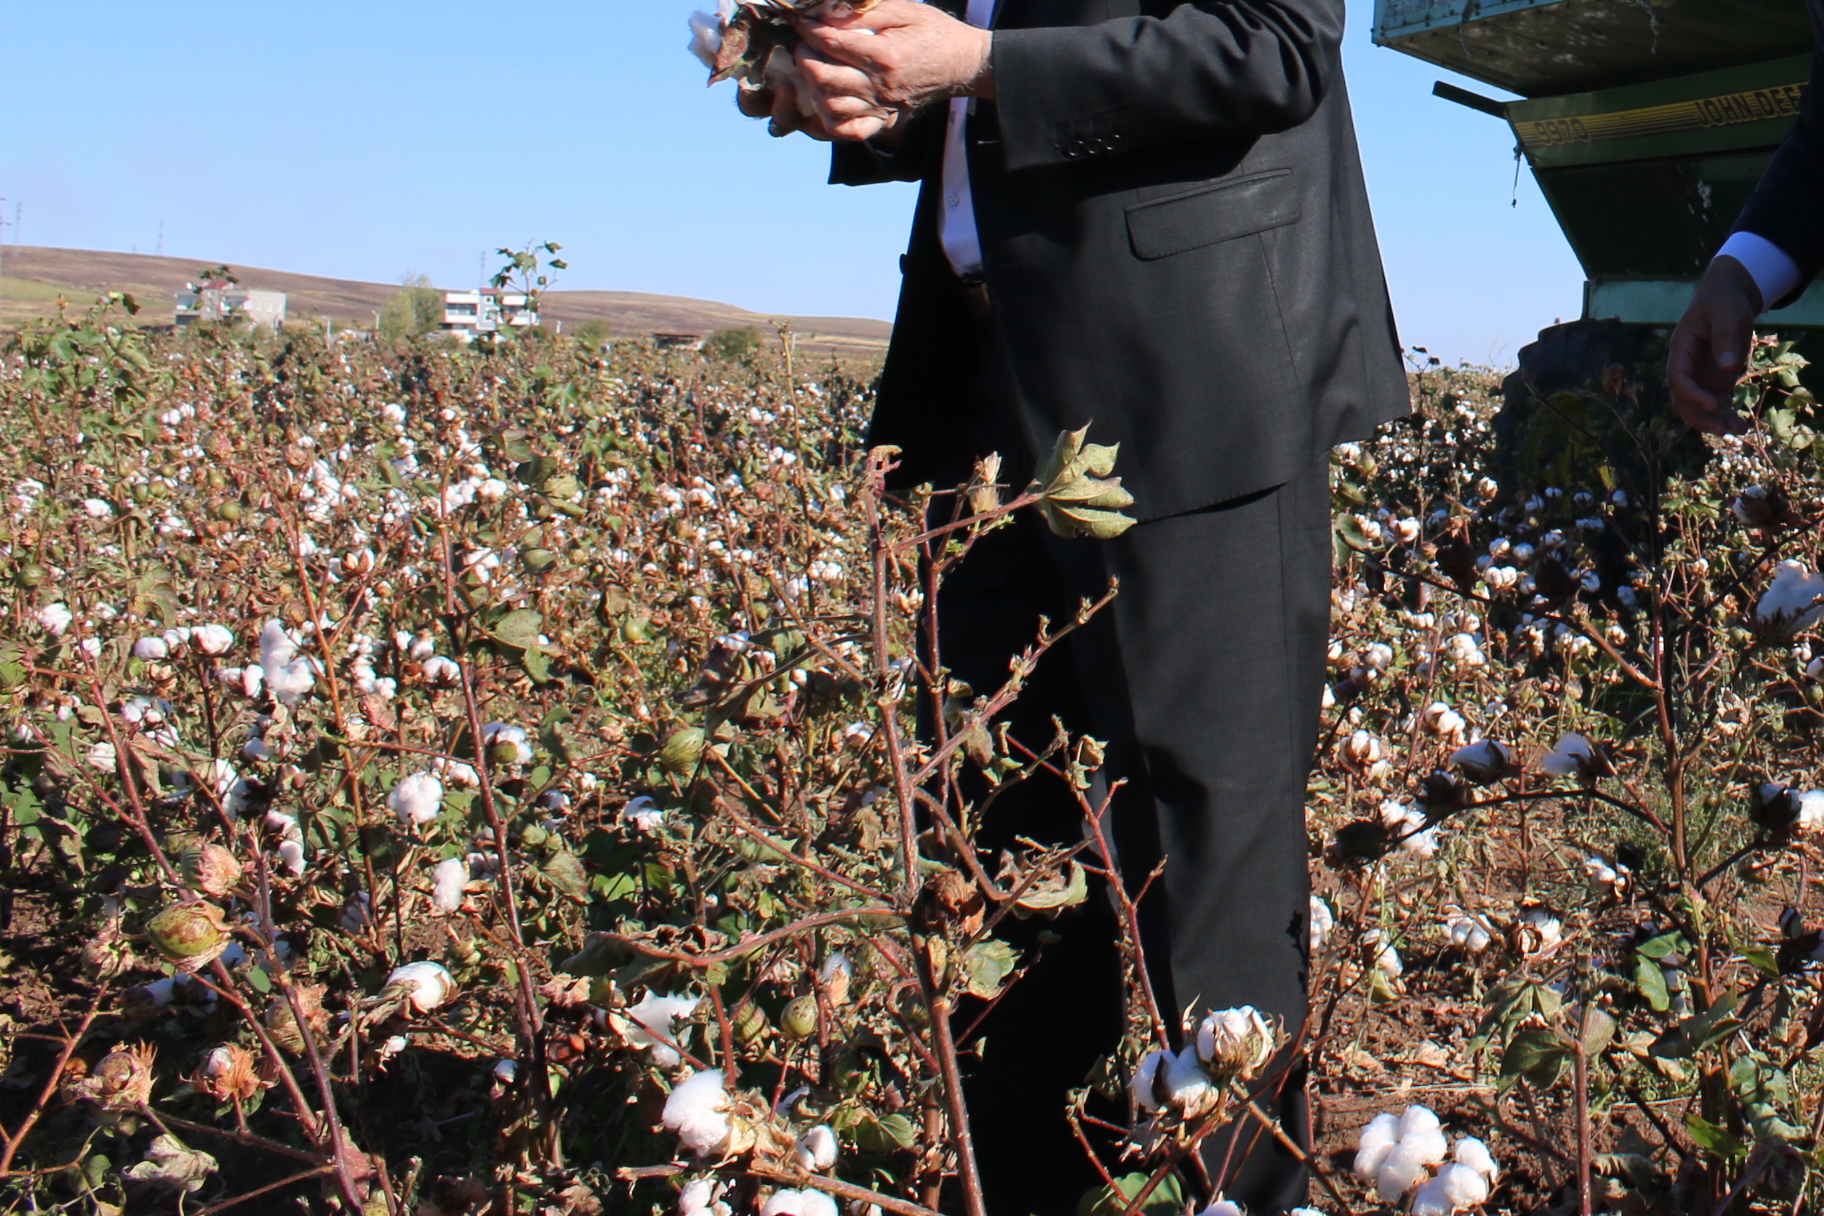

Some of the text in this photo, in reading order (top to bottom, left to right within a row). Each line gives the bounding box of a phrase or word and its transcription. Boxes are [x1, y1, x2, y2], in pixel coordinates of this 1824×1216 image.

[1533, 84, 1808, 145] 9970 JOHN DEE
